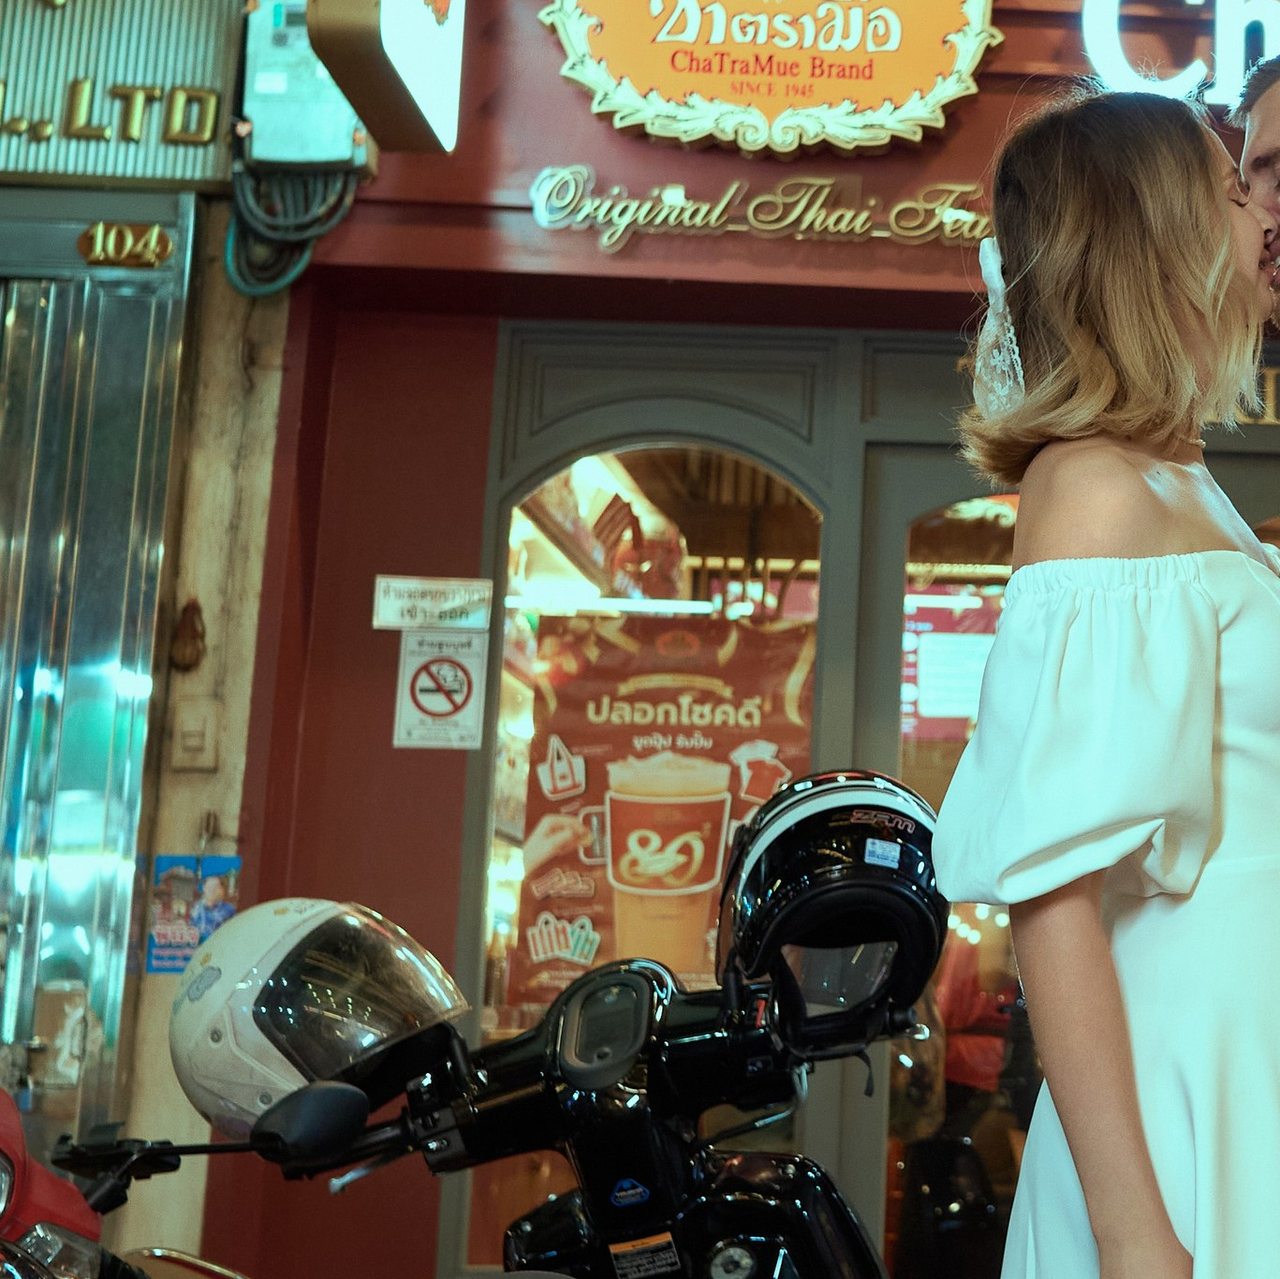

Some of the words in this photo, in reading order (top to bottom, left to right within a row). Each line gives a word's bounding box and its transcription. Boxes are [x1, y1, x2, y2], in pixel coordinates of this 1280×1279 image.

[670, 49, 800, 77] ChaTraMue
[810, 55, 874, 80] Brand
[731, 81, 779, 97] SINCE
[785, 83, 814, 98] 1945
[534, 165, 740, 250] Original
[747, 176, 876, 238] Thai
[888, 183, 992, 242] Tea
[85, 224, 163, 269] 104
[587, 694, 762, 727] ปลอกโชคดี
